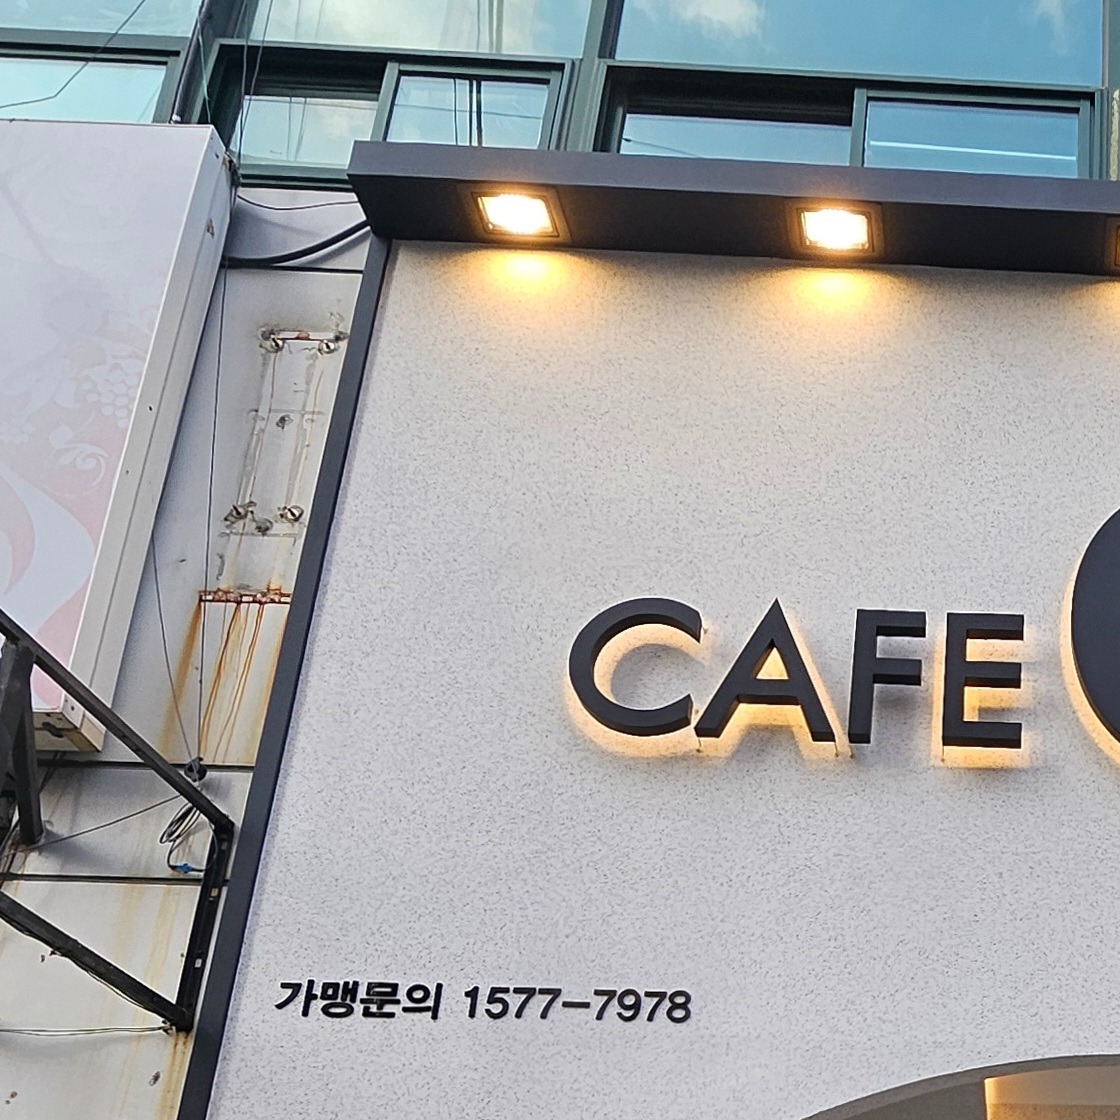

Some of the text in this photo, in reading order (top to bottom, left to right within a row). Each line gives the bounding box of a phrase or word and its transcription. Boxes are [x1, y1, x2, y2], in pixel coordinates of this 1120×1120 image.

[569, 597, 1025, 749] CAFE
[274, 979, 692, 1024] 가맹문의 1577-7978
